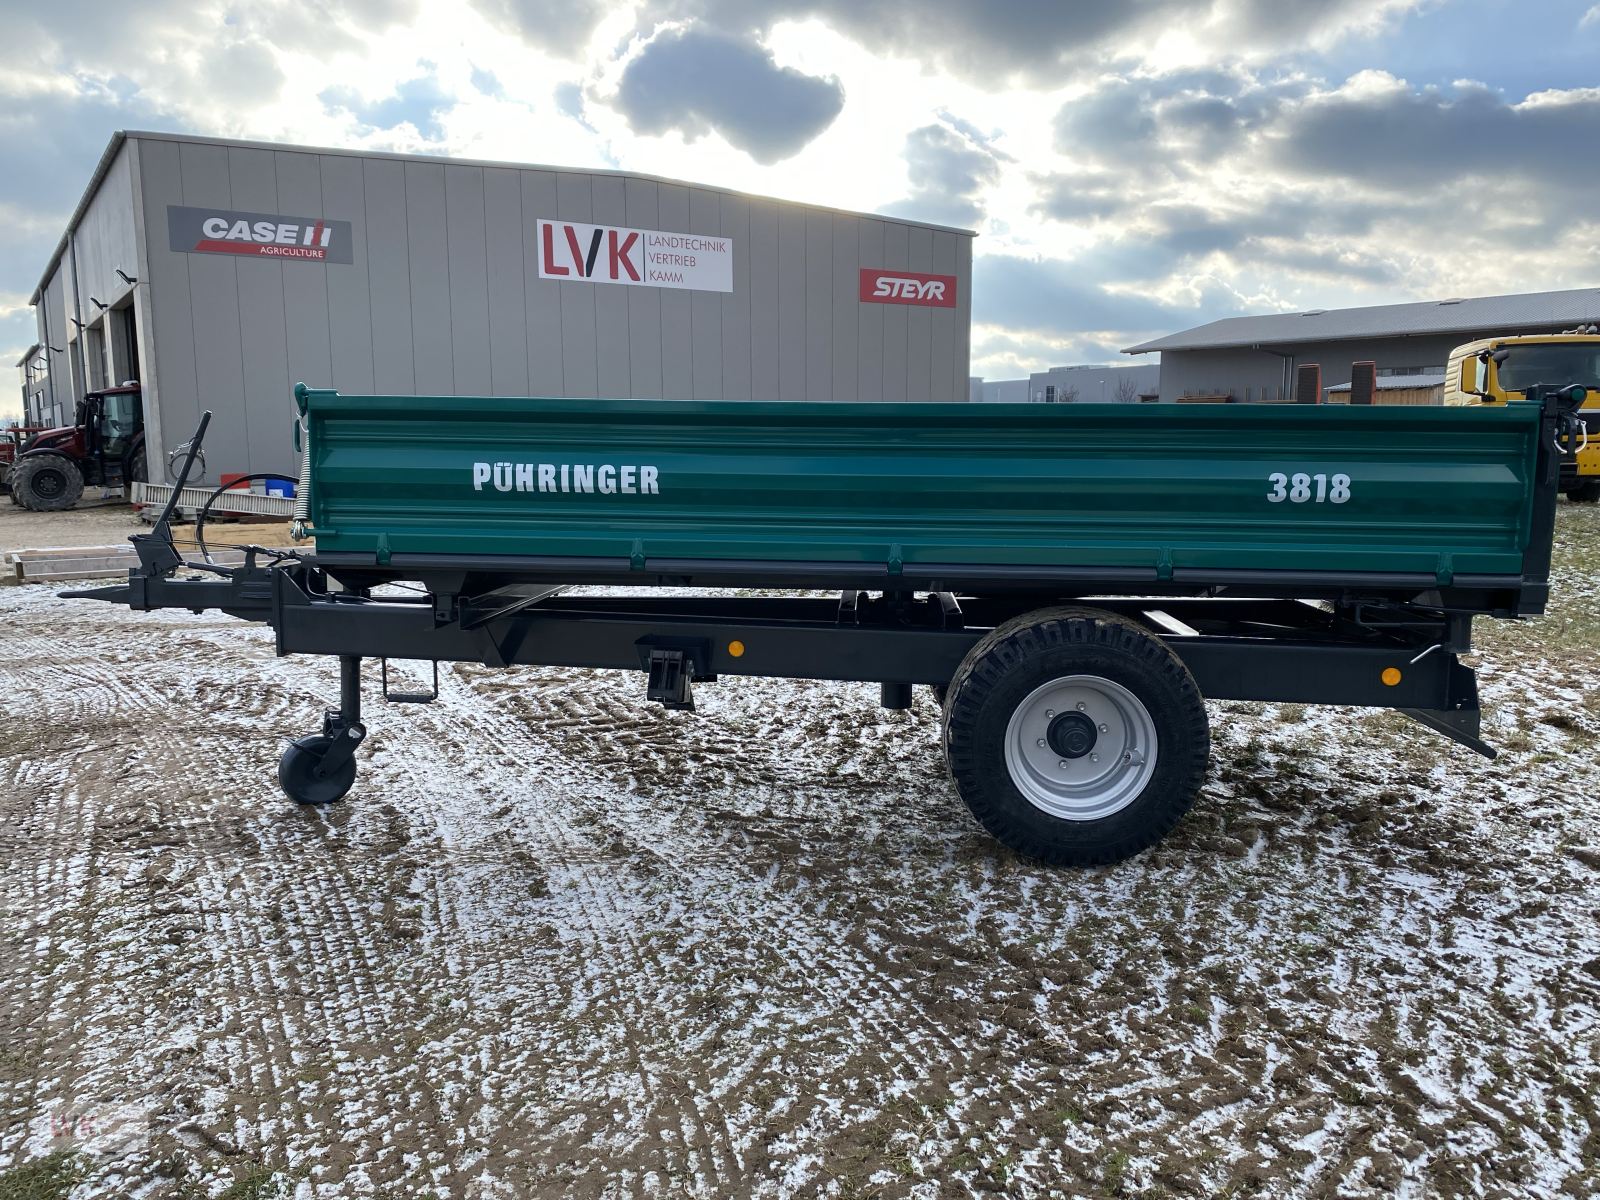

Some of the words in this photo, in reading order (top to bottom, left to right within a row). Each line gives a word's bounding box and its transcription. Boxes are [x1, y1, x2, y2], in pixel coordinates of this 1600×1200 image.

[202, 217, 299, 244] CASE
[260, 246, 324, 258] AGRICULTURE
[542, 223, 641, 282] LVK
[648, 234, 726, 253] LANDTECHNIK
[648, 252, 696, 267] VERTRIEB
[649, 269, 684, 283] KAMM
[873, 276, 946, 300] STEYR
[473, 461, 660, 494] PÜHRINGER
[1267, 472, 1351, 504] 3818
